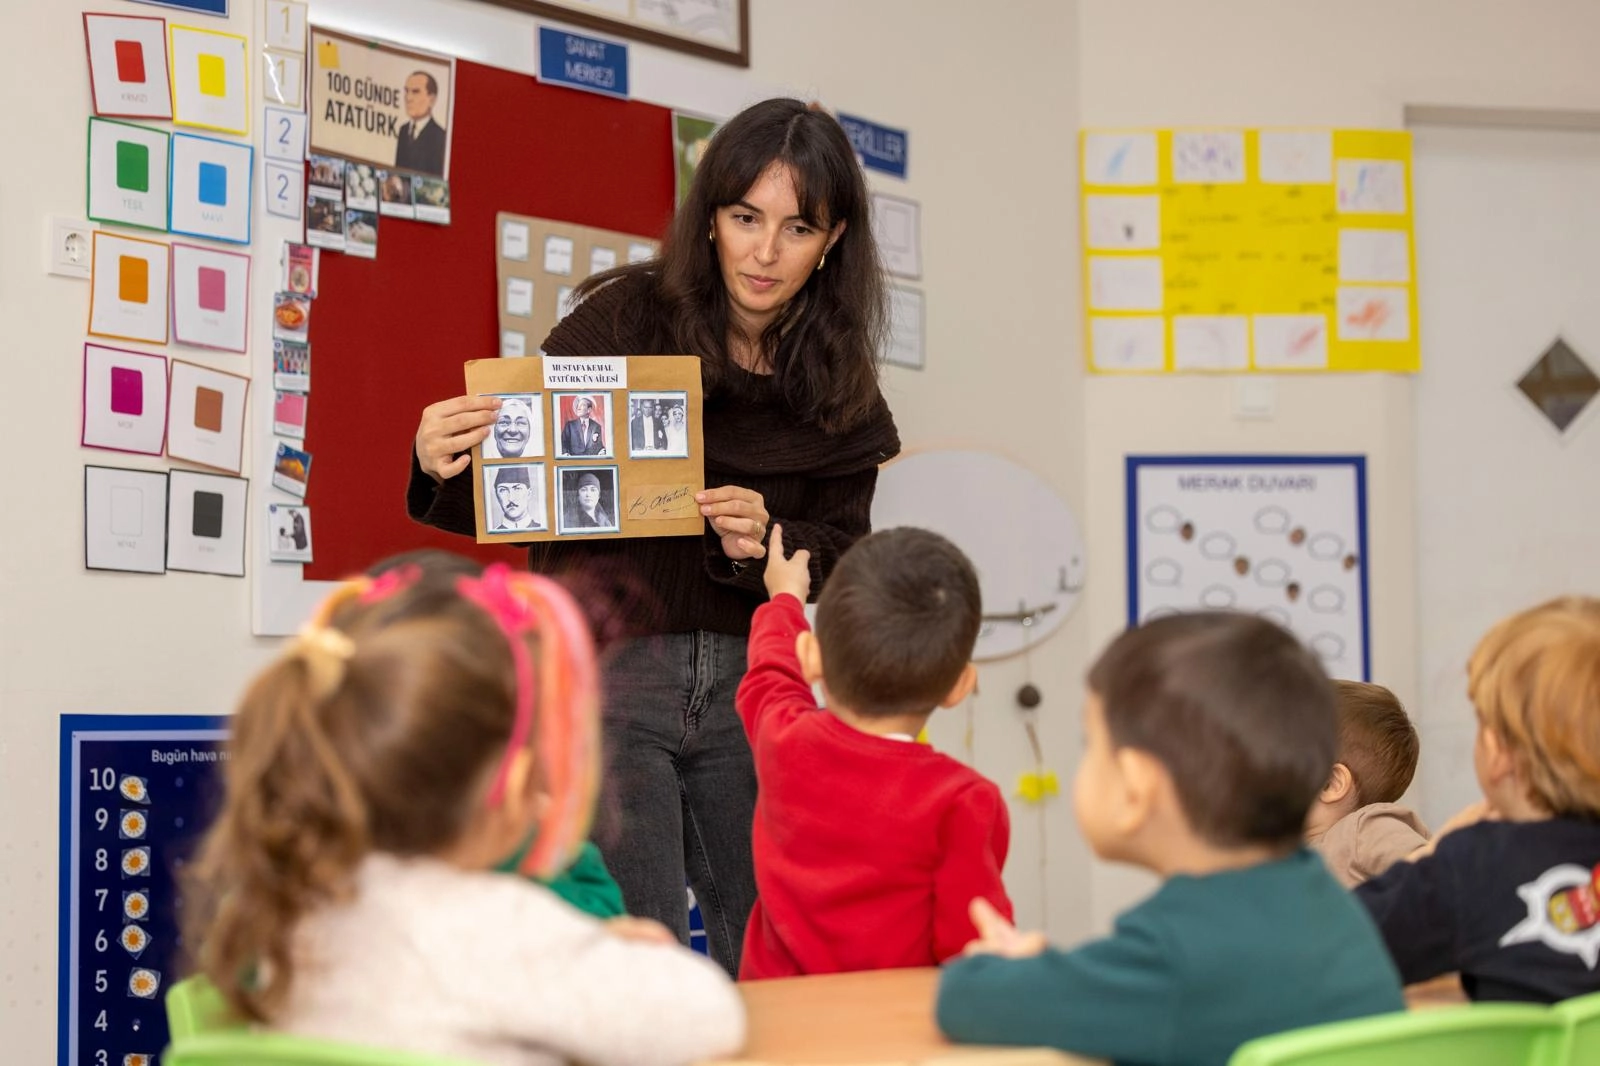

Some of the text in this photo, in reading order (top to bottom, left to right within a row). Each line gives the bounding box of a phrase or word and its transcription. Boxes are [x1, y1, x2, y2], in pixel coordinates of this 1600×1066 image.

[565, 35, 606, 60] SANAT
[327, 71, 400, 109] 100 GÜNDE
[325, 98, 399, 139] ATATÜRK
[279, 117, 291, 145] 2
[277, 173, 289, 201] 2
[552, 364, 614, 372] MUSTAFA KEMAL
[595, 373, 619, 383] AİLESİ
[151, 748, 188, 766] Bugün
[190, 748, 217, 762] hava
[90, 768, 116, 791] 10
[95, 808, 108, 831] 9
[95, 848, 108, 871] 8
[95, 889, 109, 911] 7
[95, 930, 108, 952] 6
[95, 970, 108, 993] 5
[94, 1009, 108, 1031] 4
[95, 1050, 108, 1066] 3
